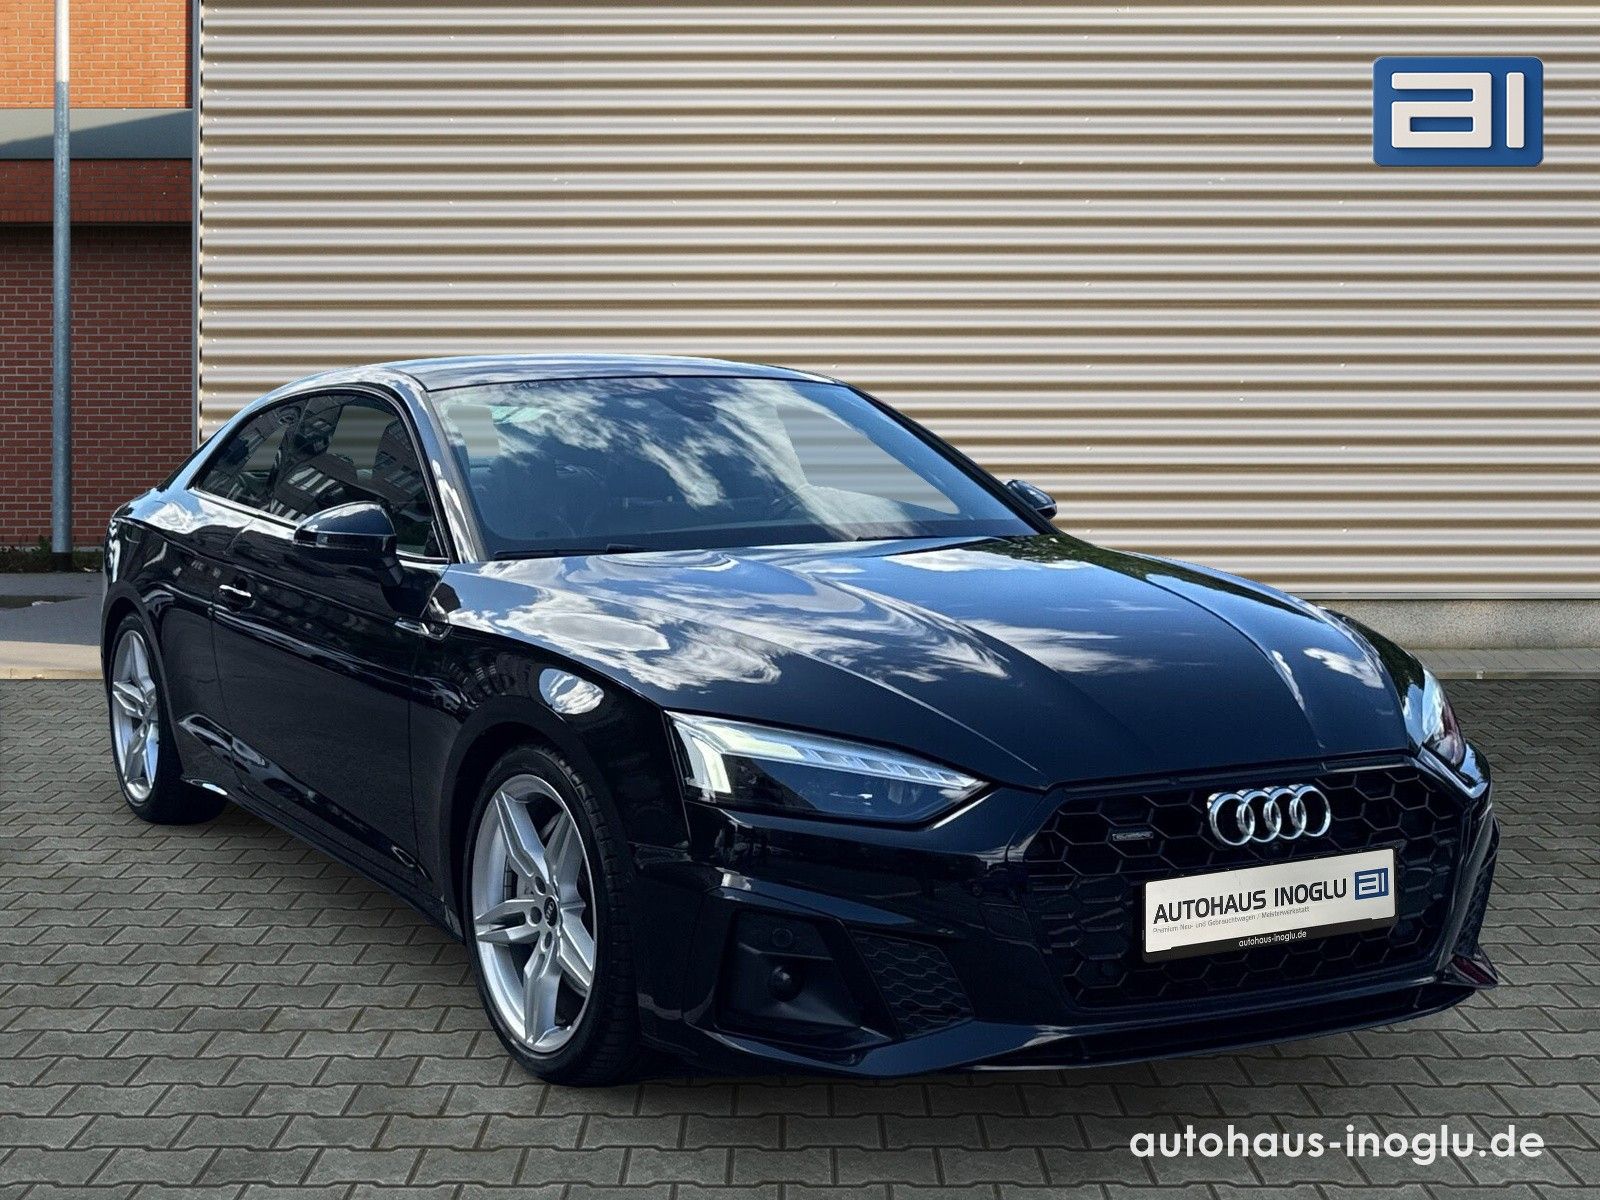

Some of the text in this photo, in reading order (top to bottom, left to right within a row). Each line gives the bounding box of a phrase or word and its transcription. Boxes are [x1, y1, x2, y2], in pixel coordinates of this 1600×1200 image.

[1152, 889, 1267, 925] AUTOHAUS
[1274, 877, 1347, 907] INOGLU
[1152, 925, 1179, 934] Premium
[1195, 920, 1207, 929] und
[1207, 914, 1256, 927] Gebrauchtwagen
[1261, 906, 1311, 919] Meisterwerkstatt
[1238, 930, 1307, 948] autohaus-inoglu.de
